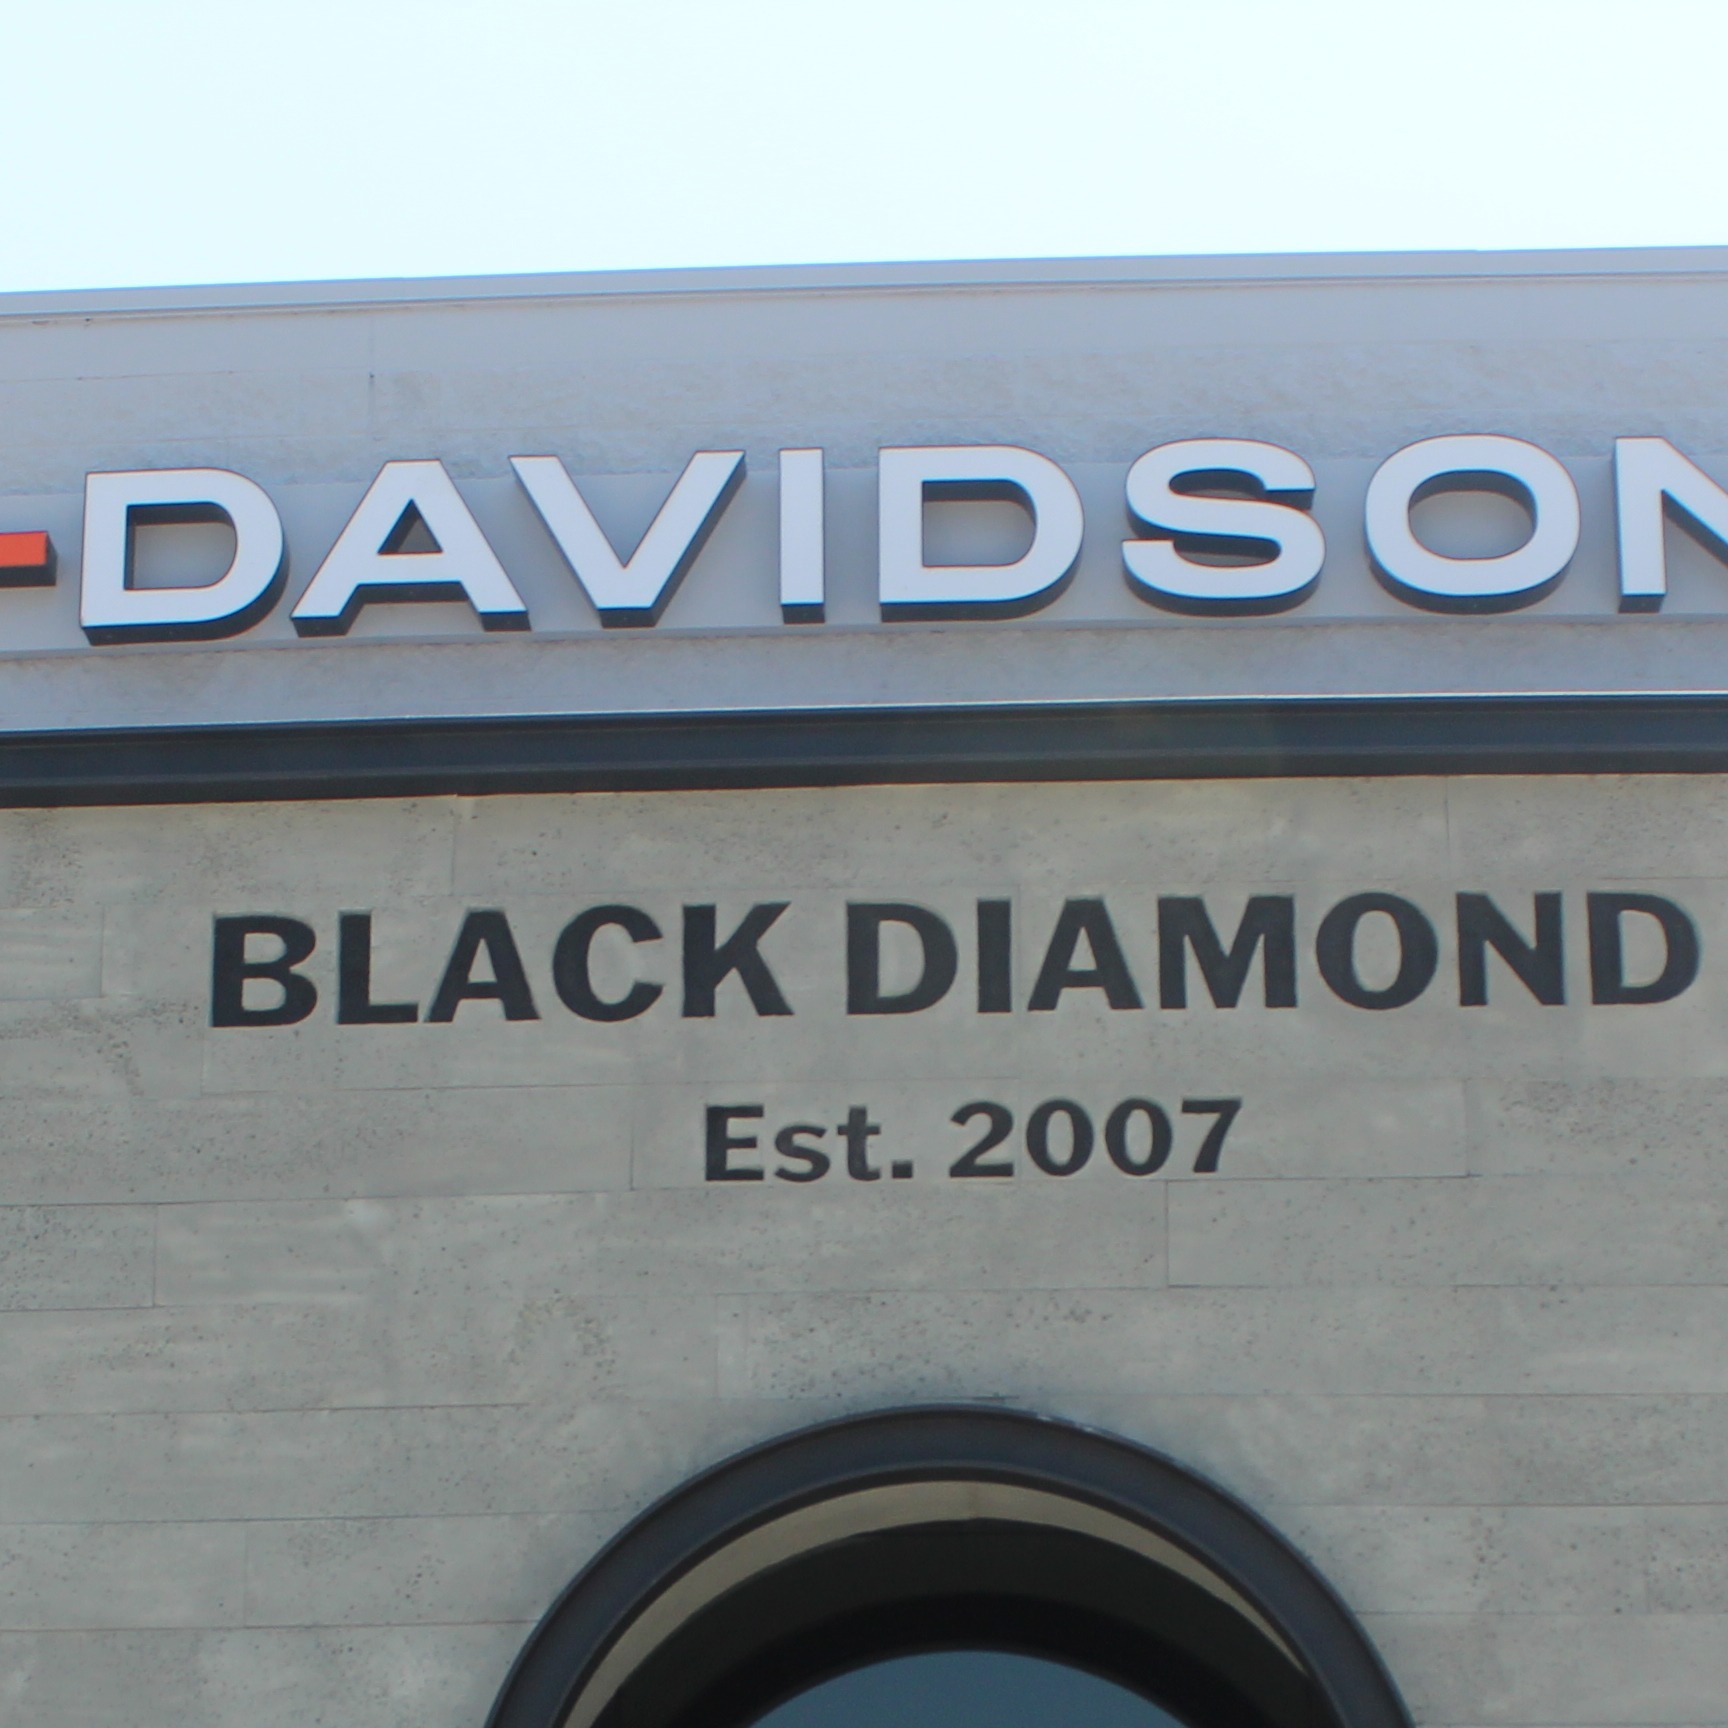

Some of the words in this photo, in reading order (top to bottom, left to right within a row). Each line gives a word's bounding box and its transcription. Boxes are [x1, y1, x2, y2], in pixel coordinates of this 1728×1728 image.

[208, 900, 793, 1028] BLACK
[844, 890, 1702, 1016] DIAMOND
[704, 1103, 914, 1183] Est.
[947, 1098, 1242, 1179] 2007
